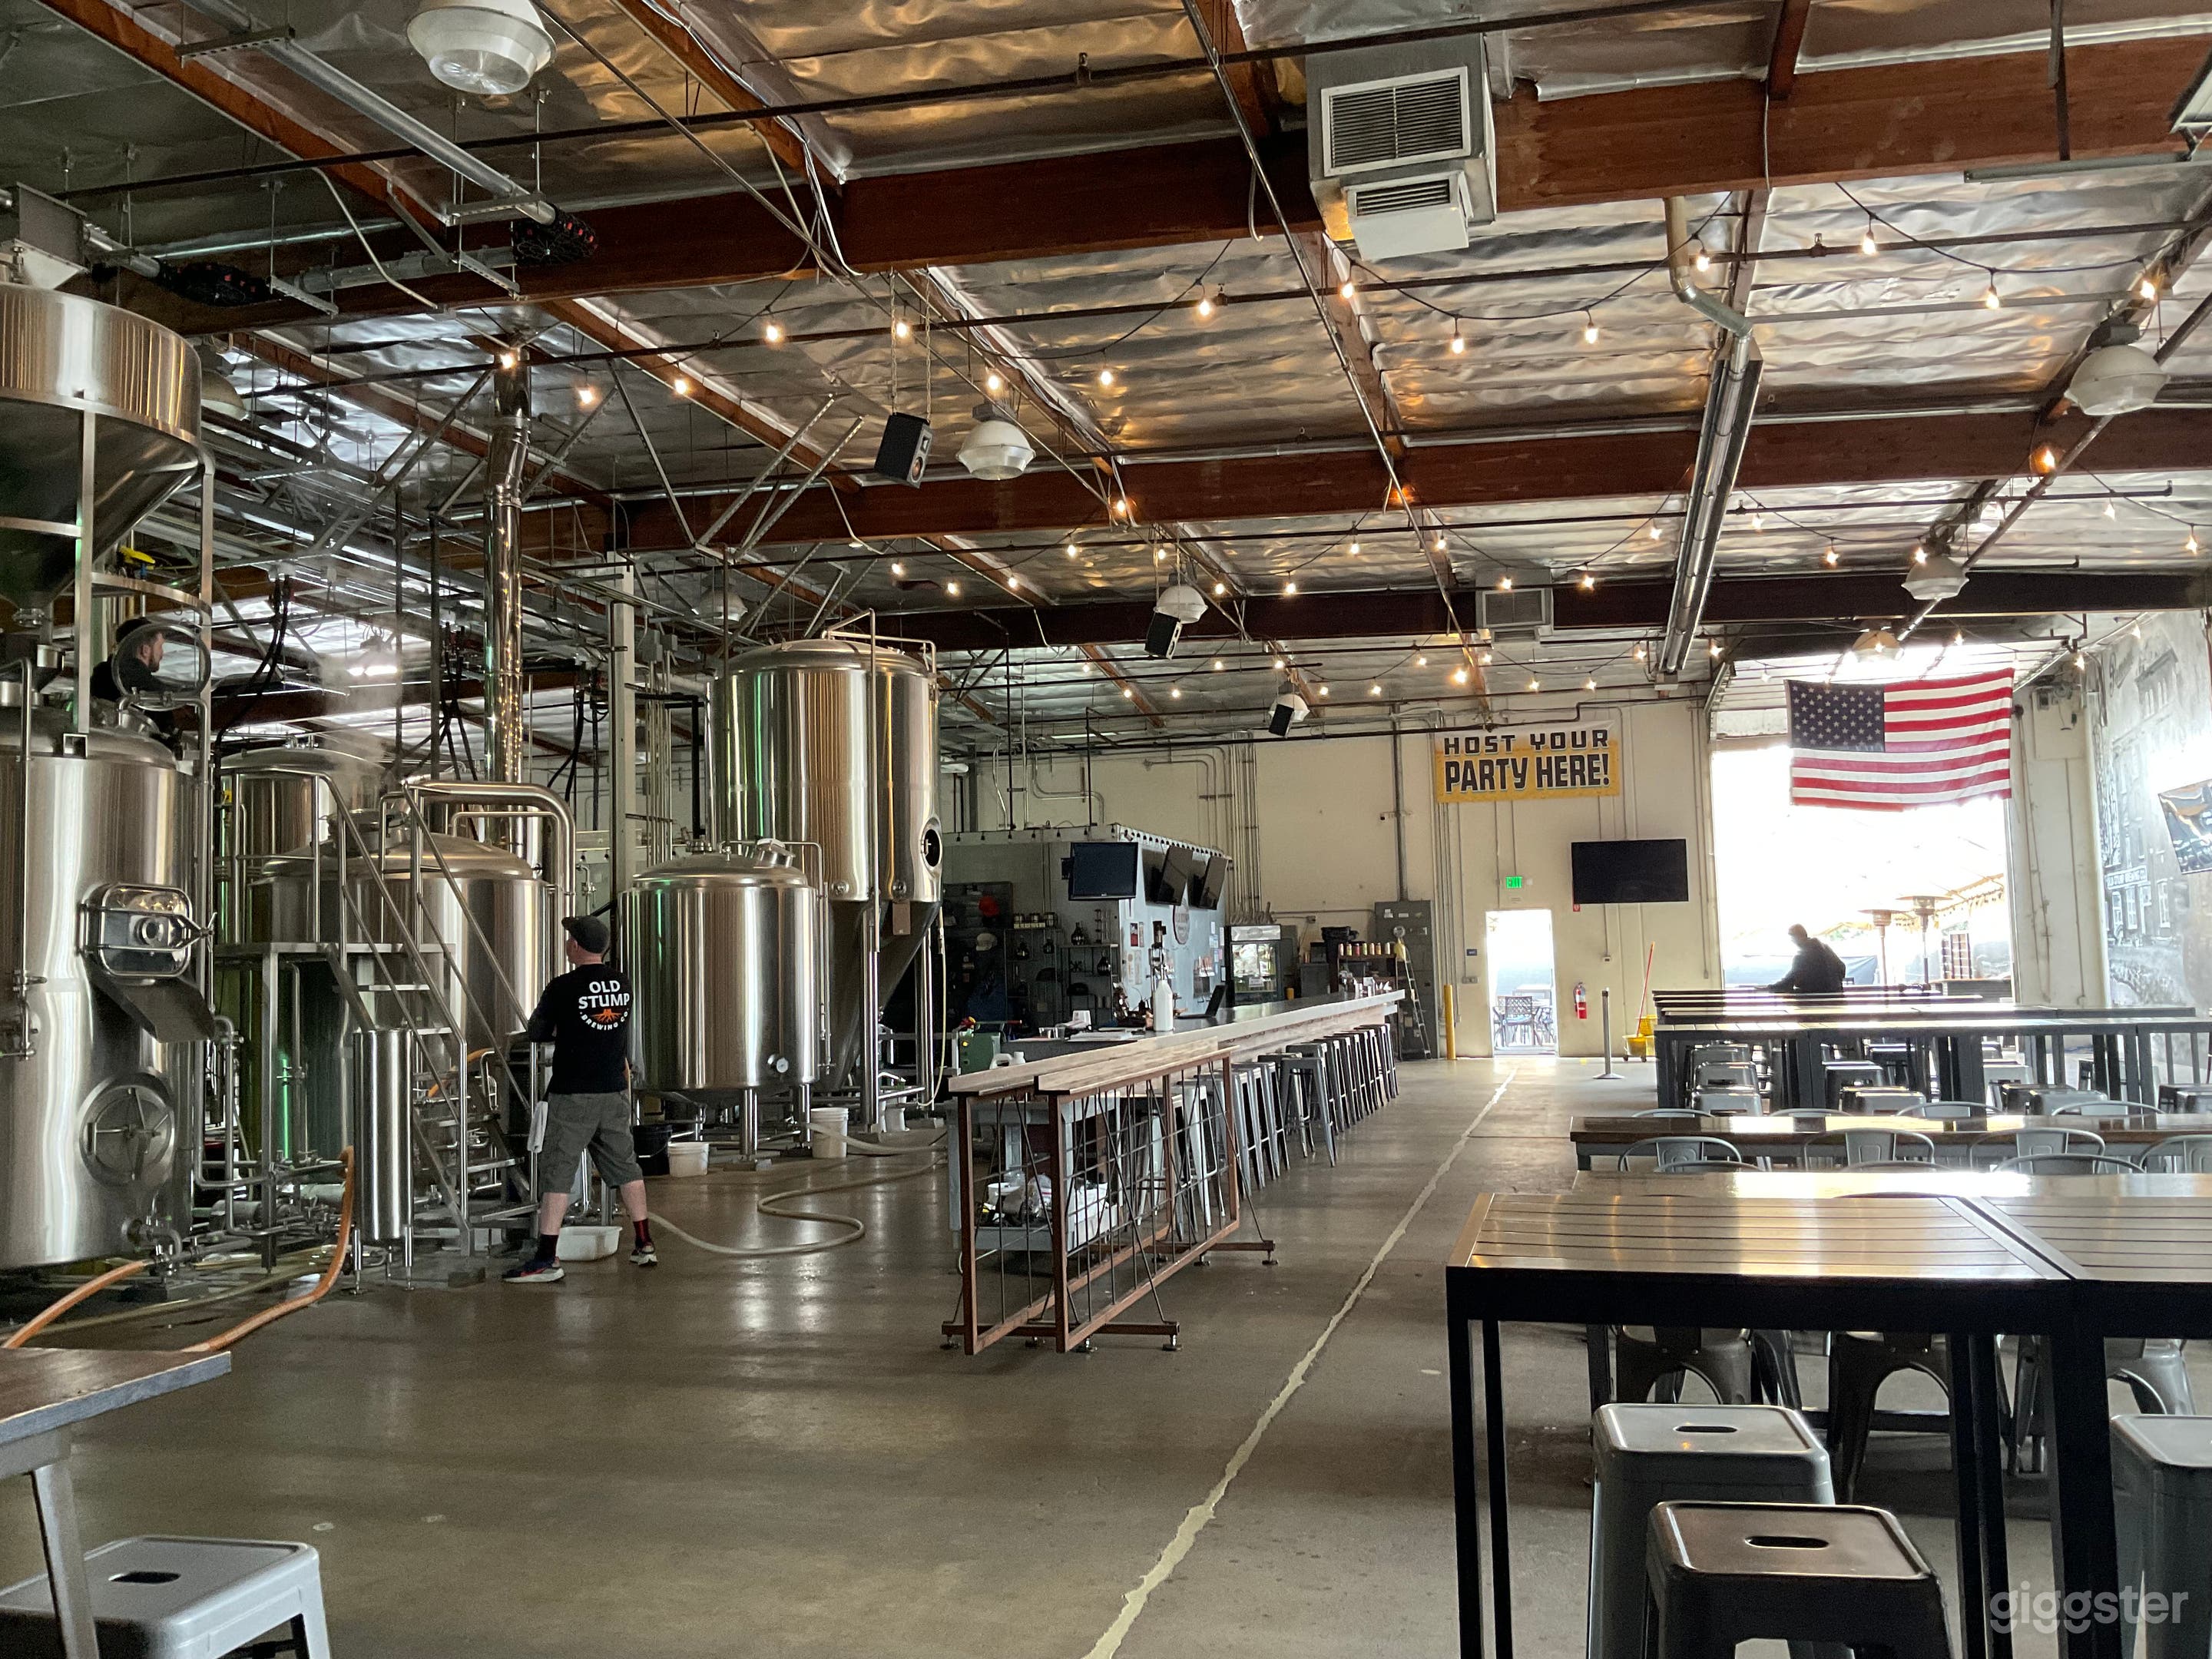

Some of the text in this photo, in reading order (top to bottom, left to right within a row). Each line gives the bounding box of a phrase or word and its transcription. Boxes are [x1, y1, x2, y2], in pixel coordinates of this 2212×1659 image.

[1444, 730, 1608, 755] HOST YOUR
[1445, 753, 1610, 793] PARTY HERE!
[589, 980, 621, 994] OLD
[578, 993, 630, 1010] STUMP
[581, 1014, 618, 1031] BREWING
